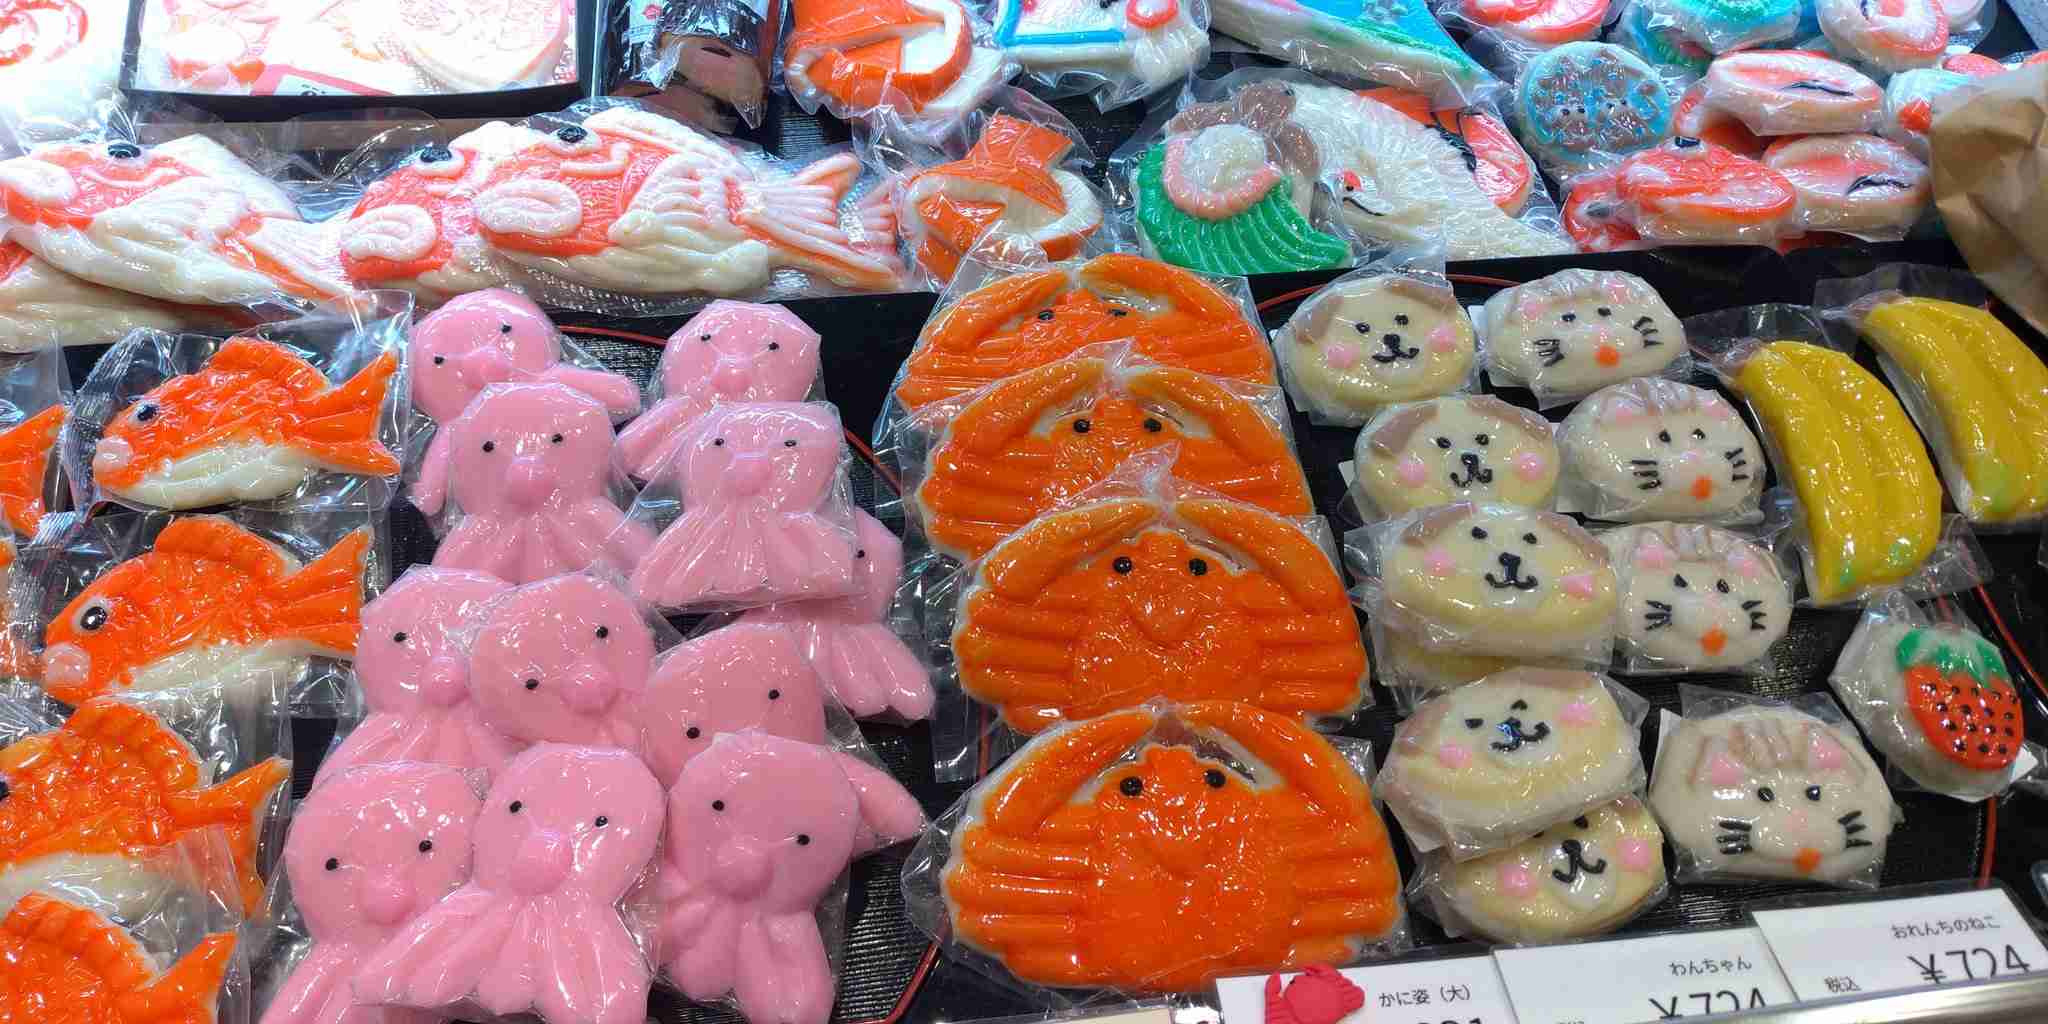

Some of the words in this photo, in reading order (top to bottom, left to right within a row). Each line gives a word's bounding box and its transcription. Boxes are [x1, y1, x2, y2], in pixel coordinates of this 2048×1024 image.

[1892, 916, 2000, 938] おれんちのねこ
[1669, 957, 1752, 976] わんちゃん
[1907, 944, 2030, 984] ¥724
[1824, 976, 1861, 992] 税込
